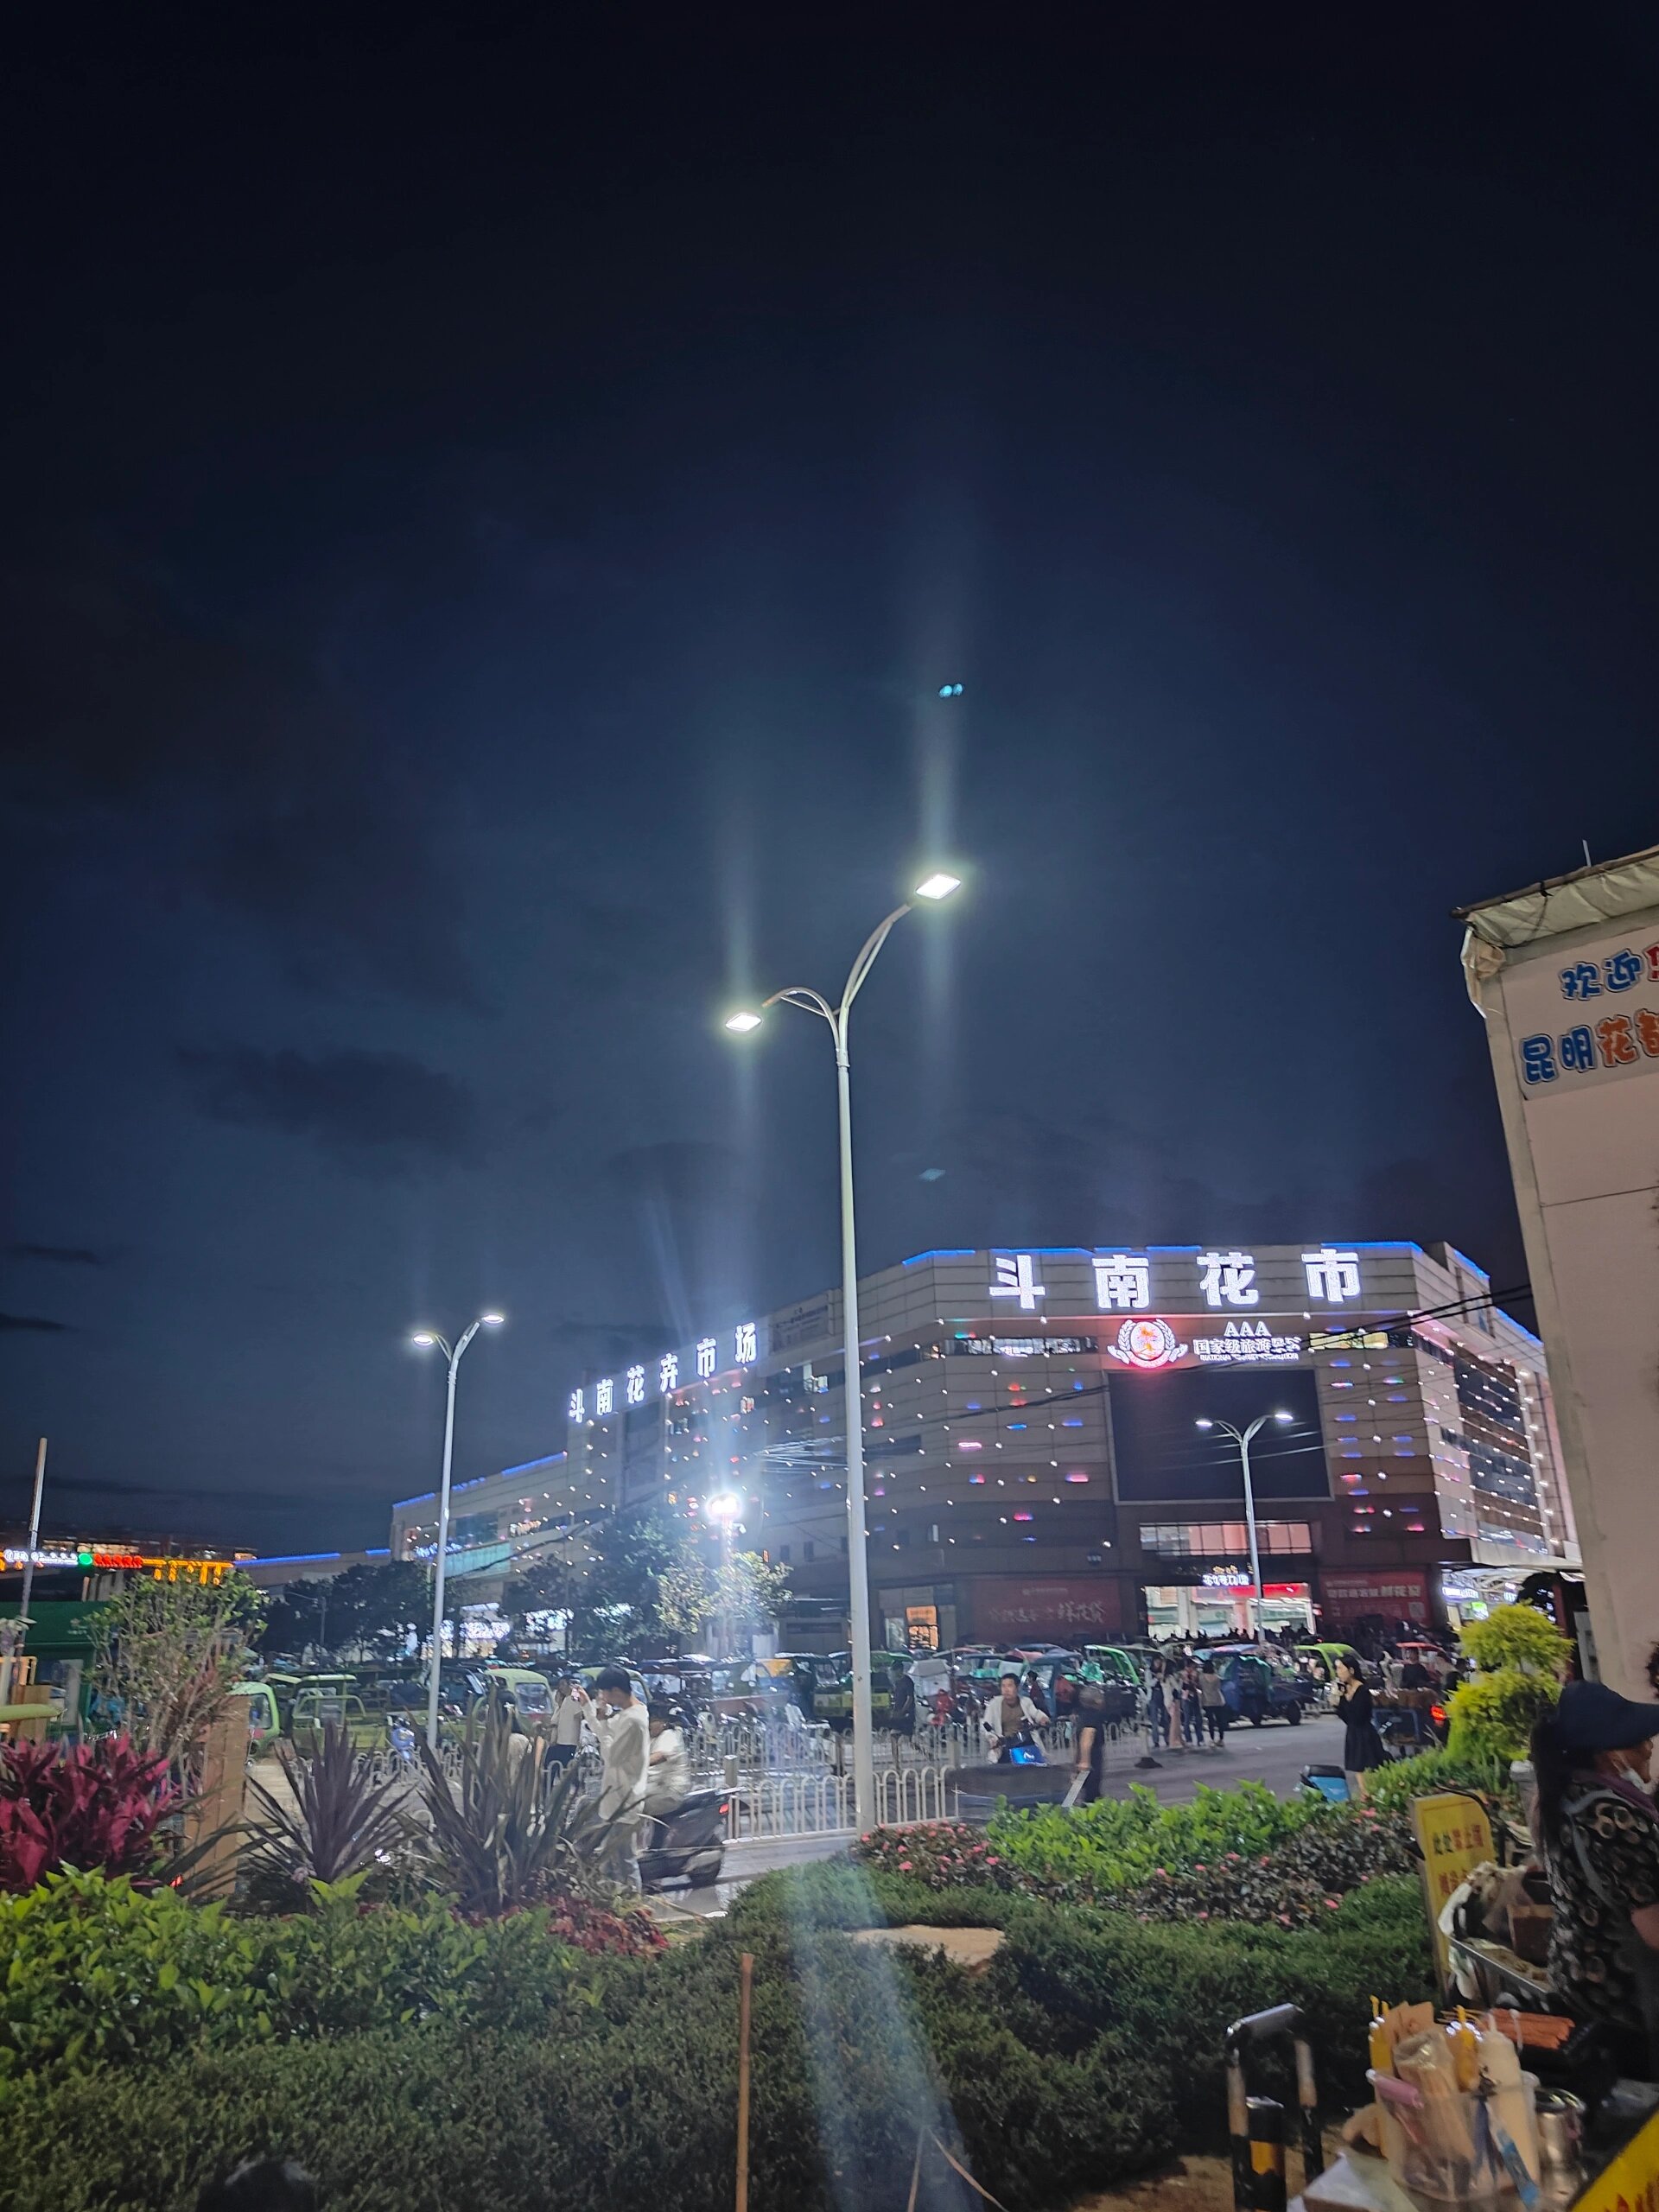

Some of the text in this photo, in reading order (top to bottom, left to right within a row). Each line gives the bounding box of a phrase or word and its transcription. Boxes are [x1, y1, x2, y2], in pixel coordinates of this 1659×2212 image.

[988, 1249, 1361, 1310] 斗南花市
[1224, 1321, 1272, 1337] AAA
[568, 1322, 758, 1424] 斗南花卉市场
